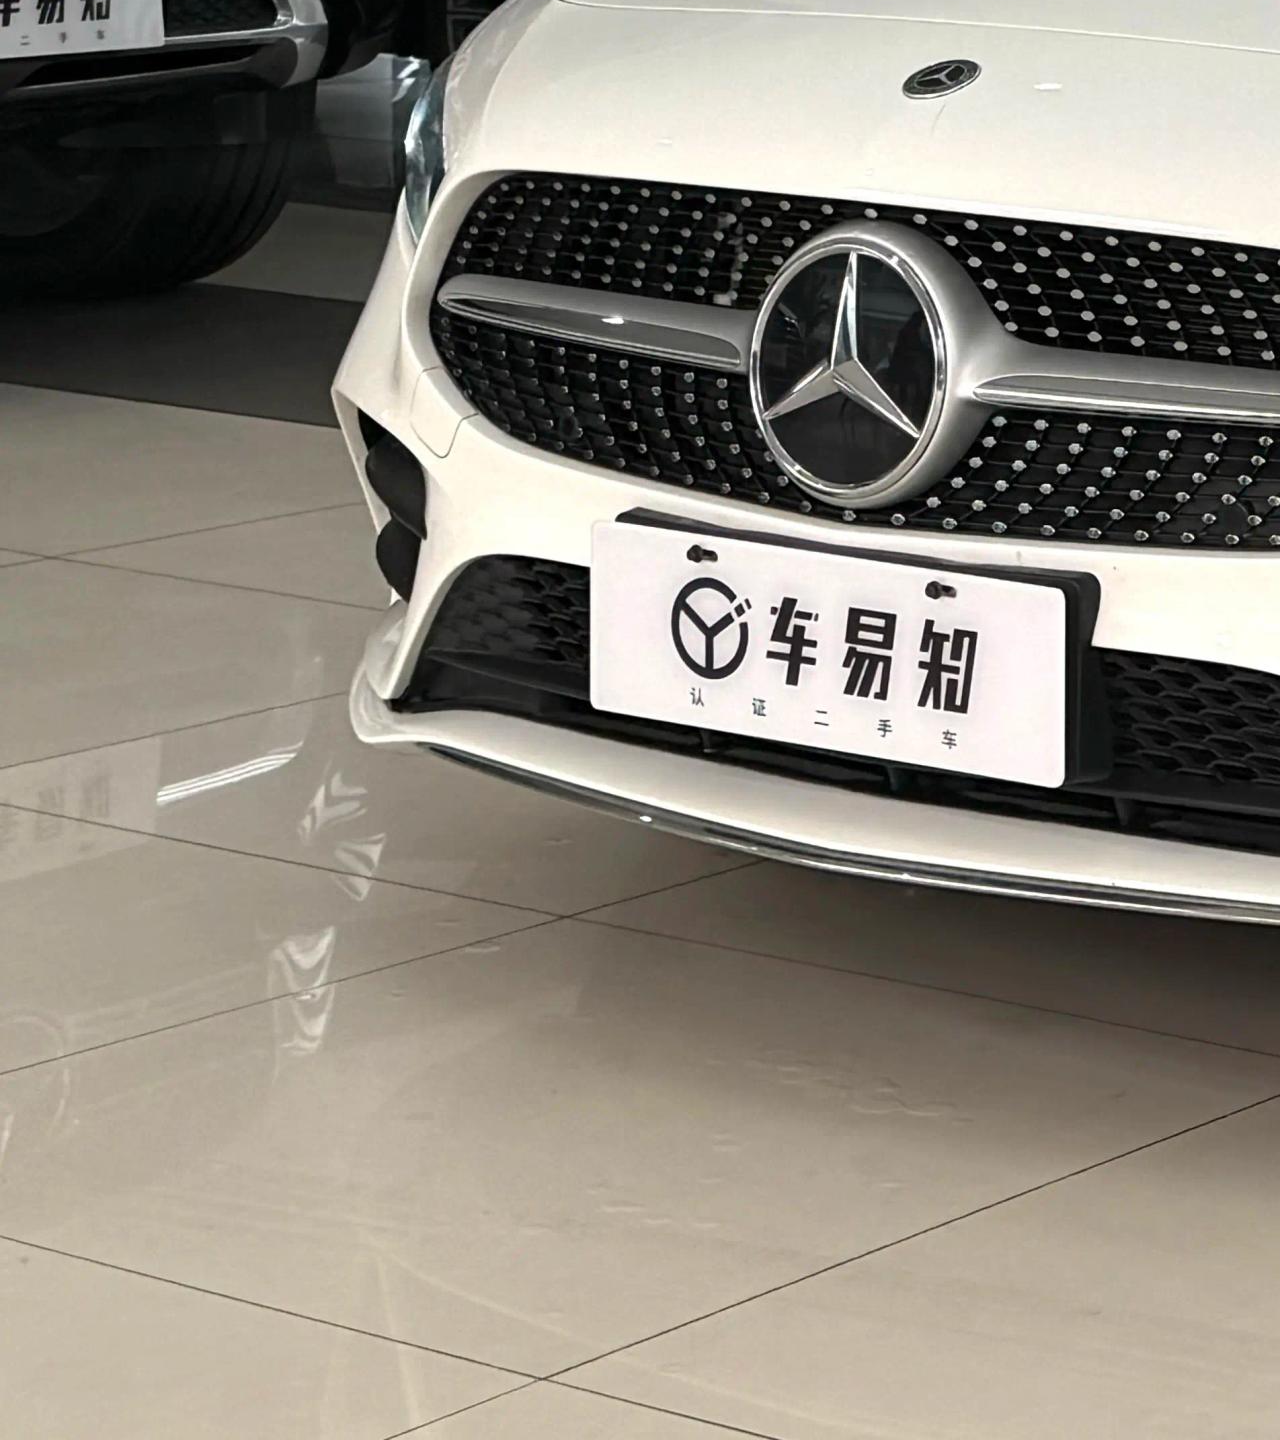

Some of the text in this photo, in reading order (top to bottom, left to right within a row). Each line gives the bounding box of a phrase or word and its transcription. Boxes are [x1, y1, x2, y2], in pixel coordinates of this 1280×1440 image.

[765, 596, 979, 715] 车易知
[689, 687, 958, 749] 认证二手车
